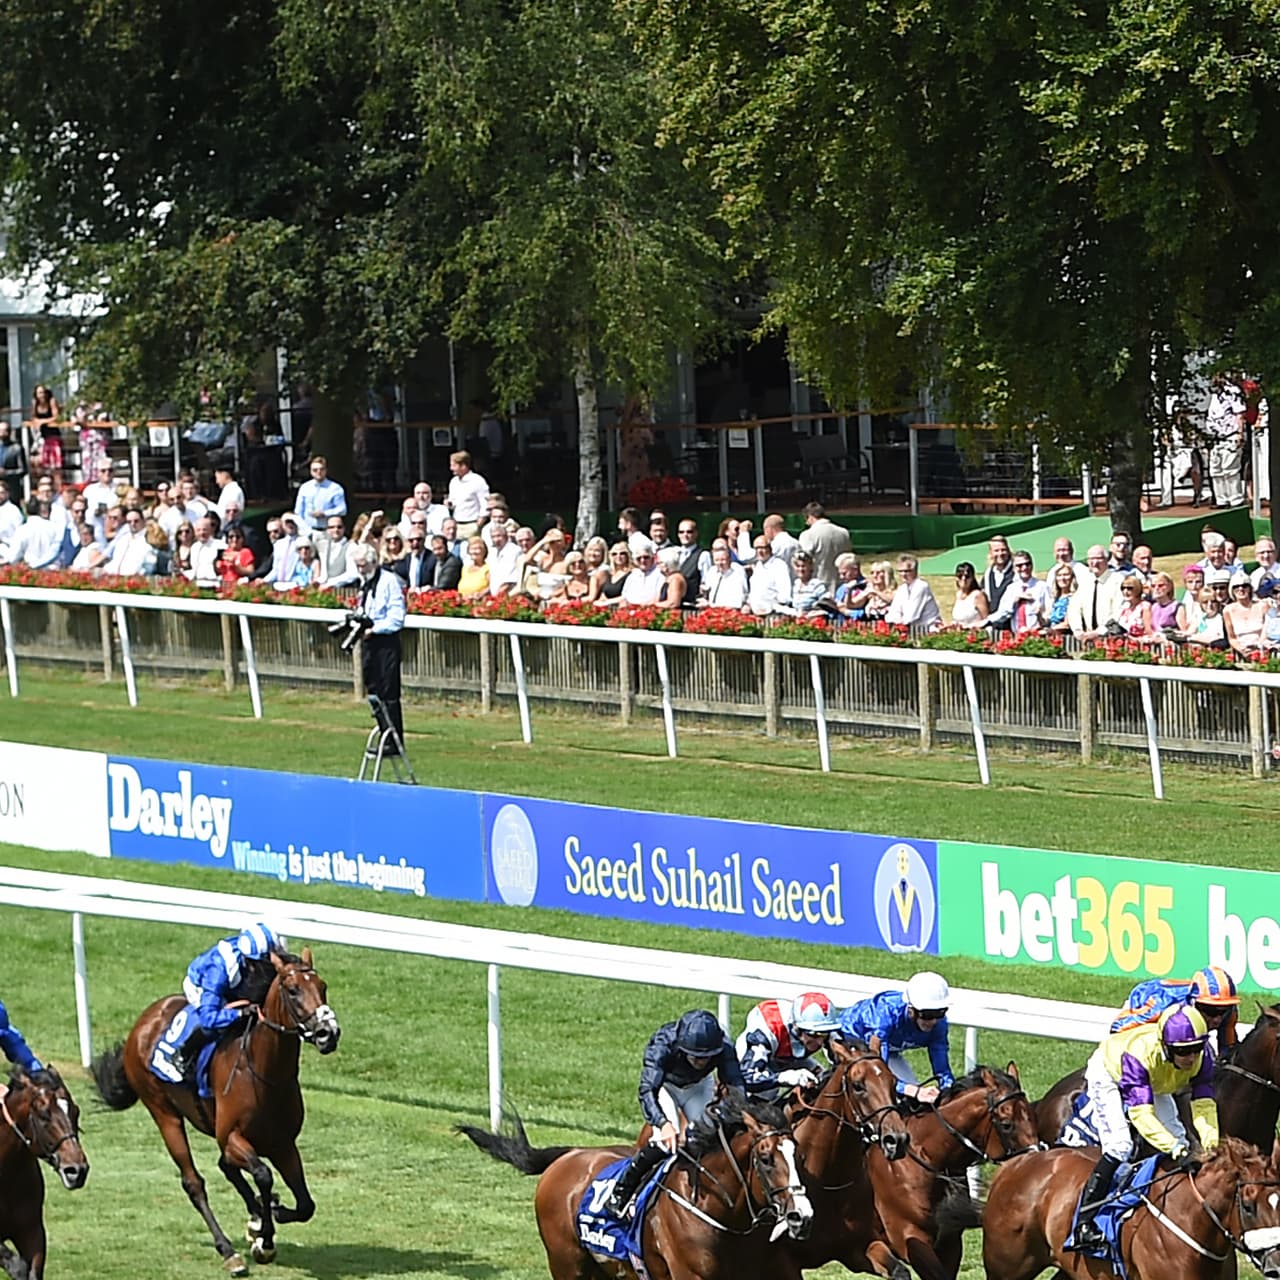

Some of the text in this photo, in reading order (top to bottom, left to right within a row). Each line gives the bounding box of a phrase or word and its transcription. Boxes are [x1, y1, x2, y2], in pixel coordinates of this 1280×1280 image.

[108, 763, 232, 857] Darley
[231, 840, 426, 897] Winning is just the beginning
[563, 835, 845, 926] Saeed Suhail Saeed
[980, 862, 1175, 973] bet365
